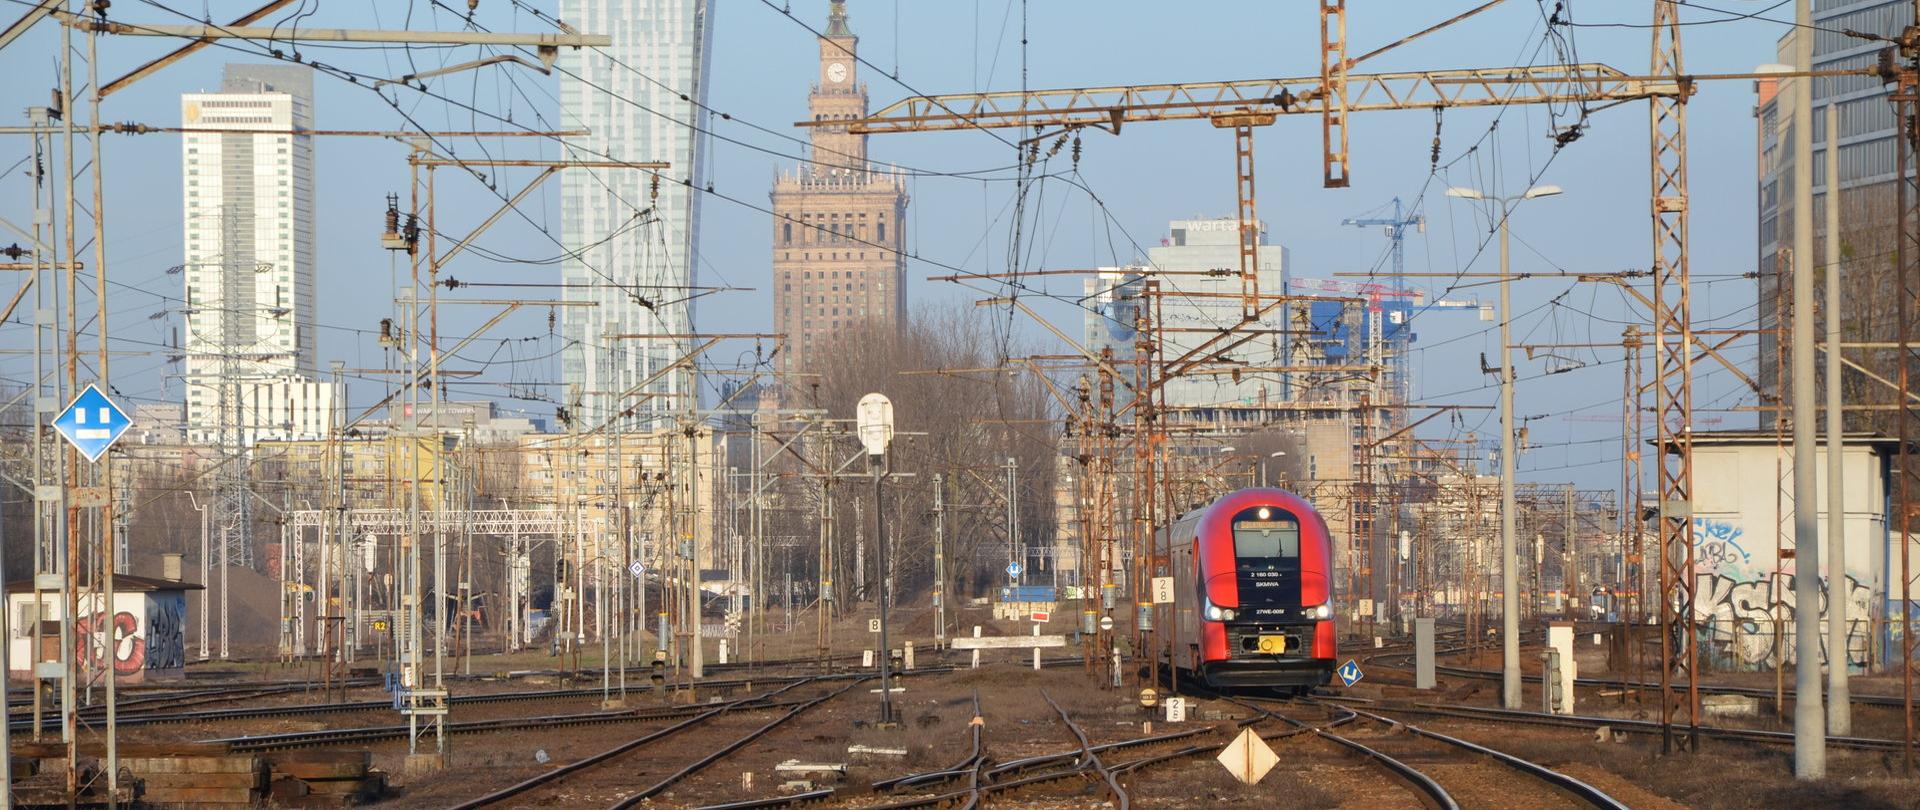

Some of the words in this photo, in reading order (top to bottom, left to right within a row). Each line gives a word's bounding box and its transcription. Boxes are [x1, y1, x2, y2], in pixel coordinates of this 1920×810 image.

[1187, 221, 1238, 232] warta
[1160, 579, 1166, 590] 2
[1160, 591, 1167, 601] 8
[374, 621, 386, 630] R2
[872, 620, 879, 630] 8
[1172, 699, 1179, 709] 2
